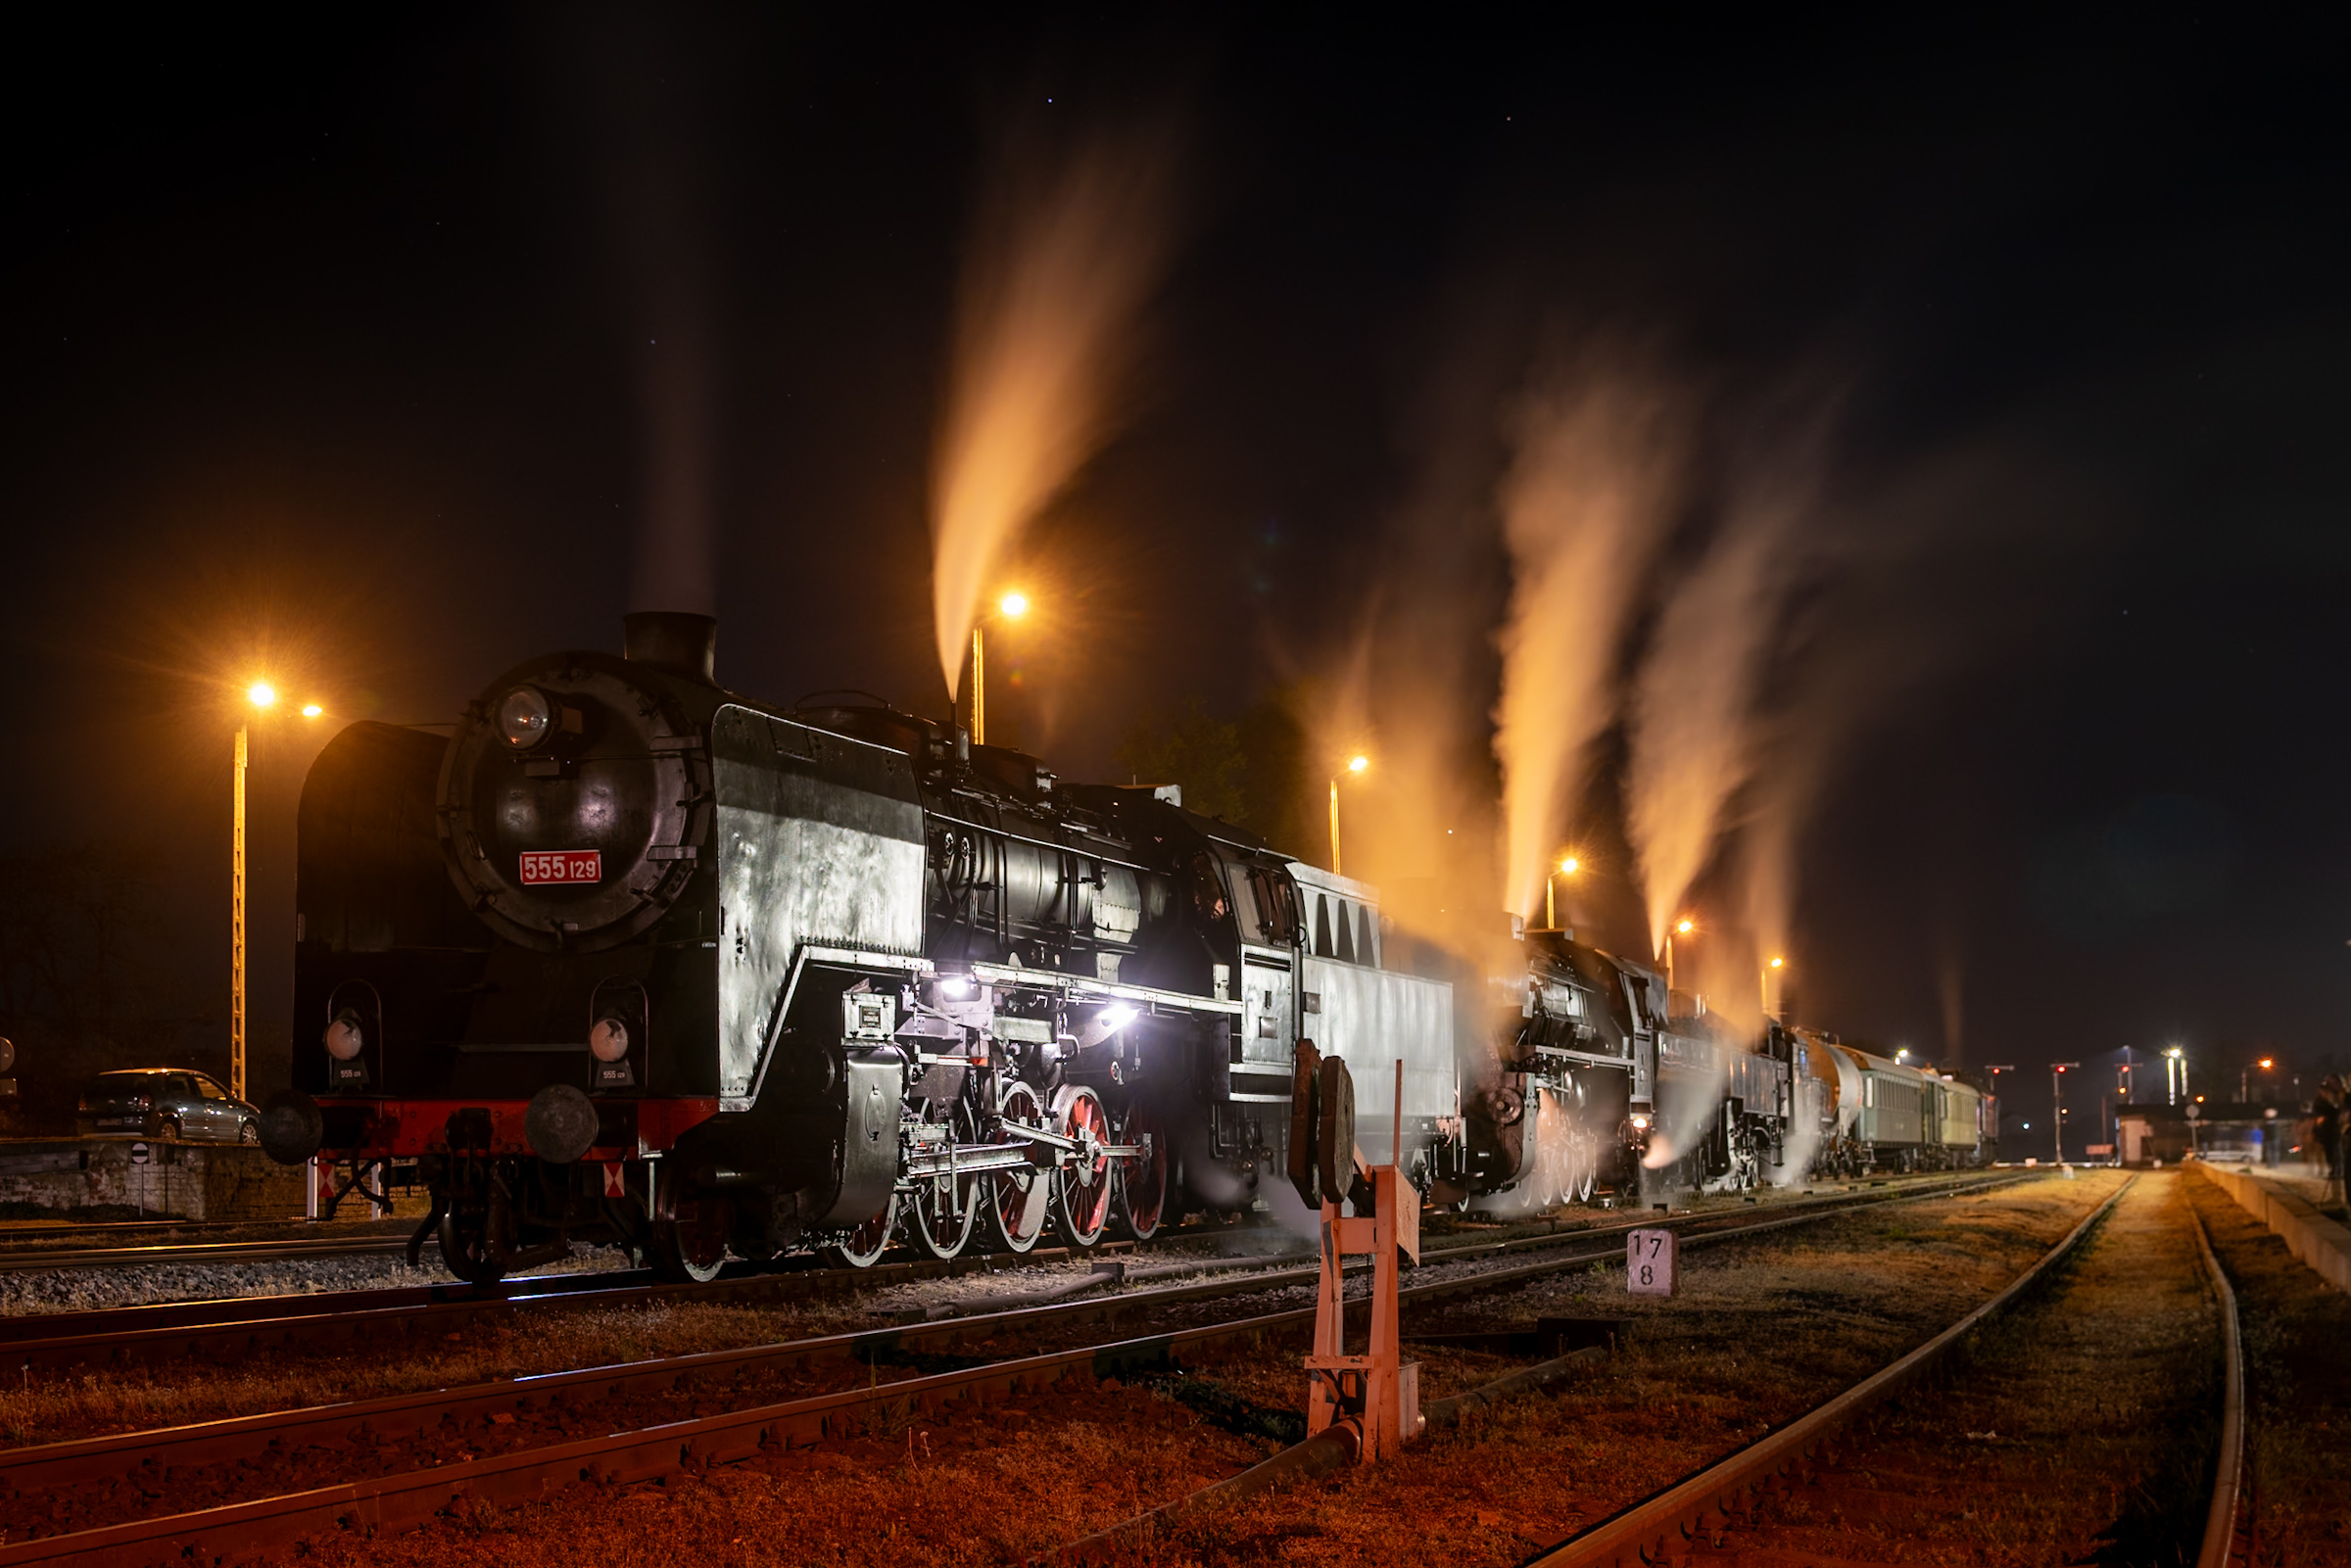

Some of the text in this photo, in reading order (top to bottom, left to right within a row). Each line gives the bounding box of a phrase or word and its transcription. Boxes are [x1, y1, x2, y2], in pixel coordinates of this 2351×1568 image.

[524, 856, 596, 879] 555 129
[603, 1069, 616, 1079] 555
[1641, 1265, 1654, 1285] 8
